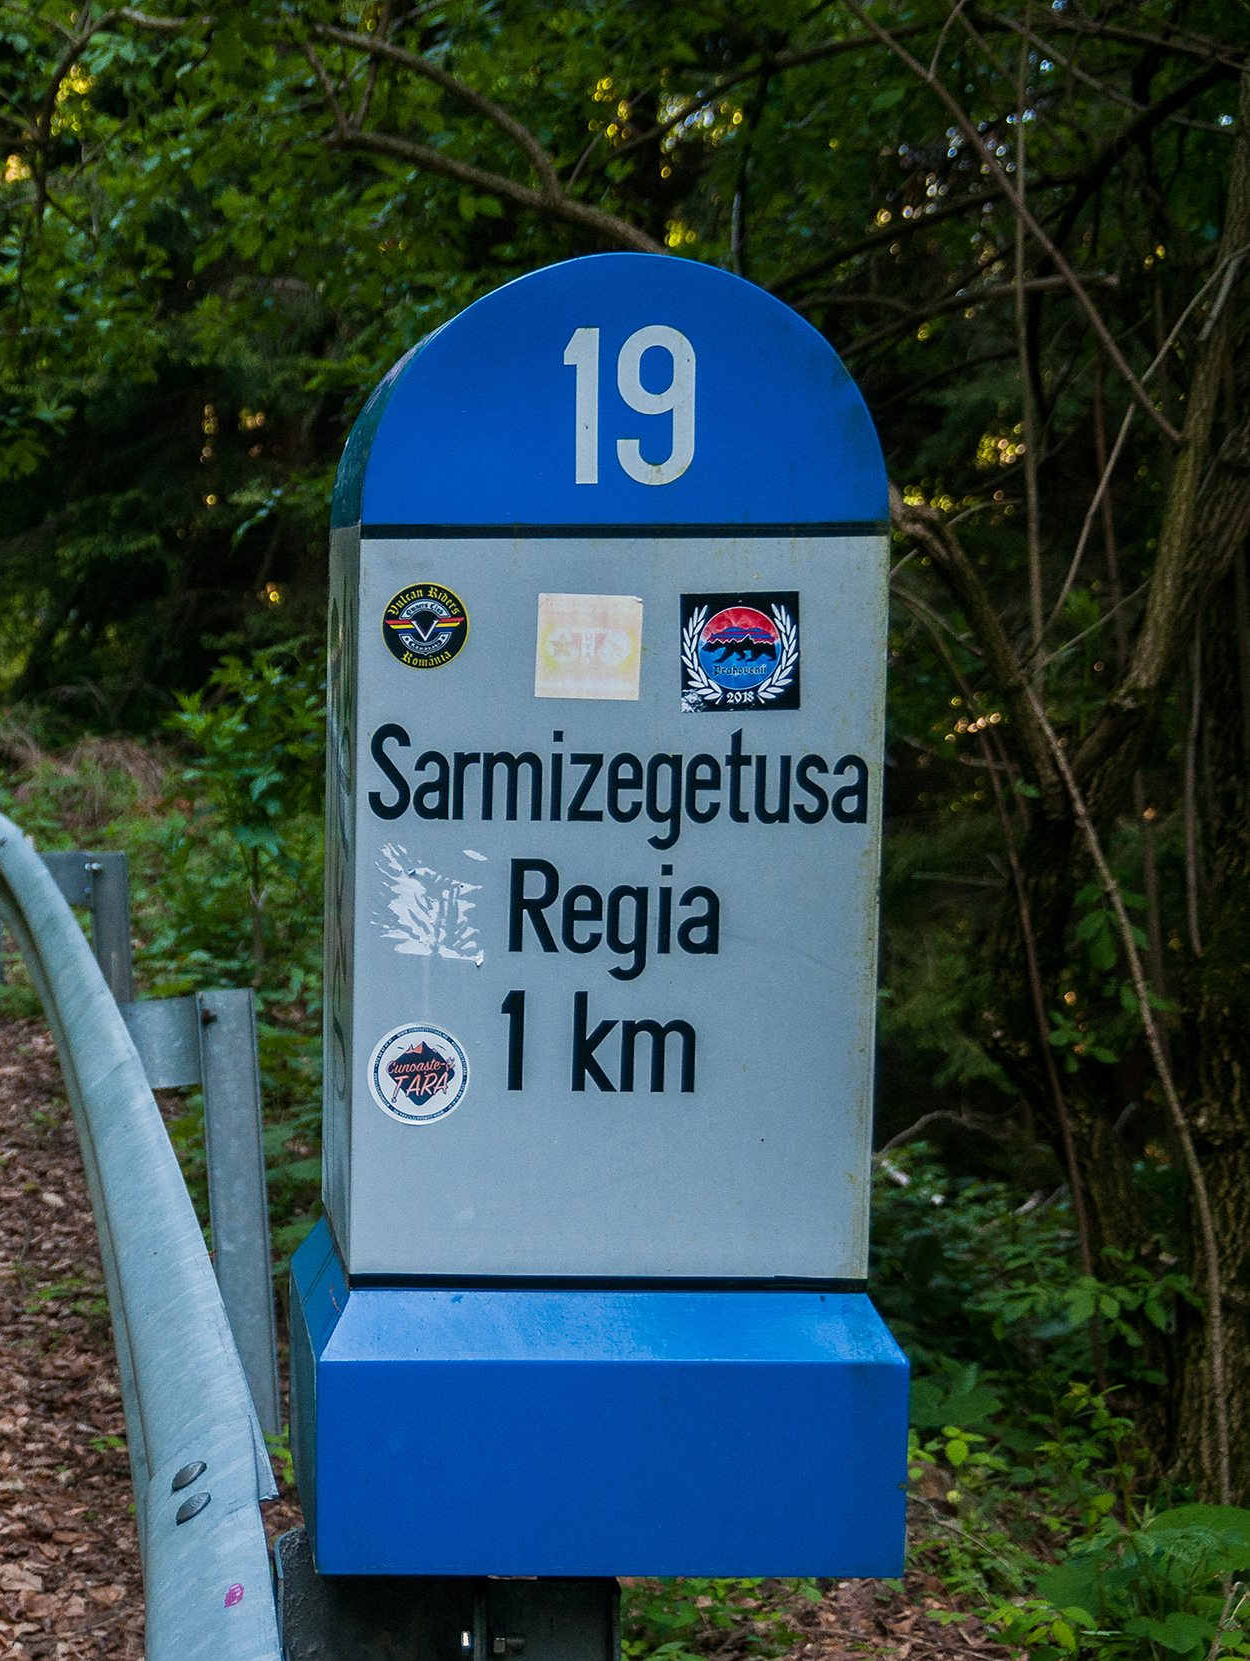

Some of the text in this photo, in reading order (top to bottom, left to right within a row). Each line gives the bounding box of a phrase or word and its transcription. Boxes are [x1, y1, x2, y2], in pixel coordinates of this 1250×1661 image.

[563, 324, 696, 485] 19
[387, 587, 461, 616] Vulcan Riders
[401, 651, 452, 667] România
[726, 691, 755, 704] 2018
[367, 723, 870, 850] Sarmizegetusa
[508, 858, 721, 981] Regia
[501, 990, 697, 1093] 1 km
